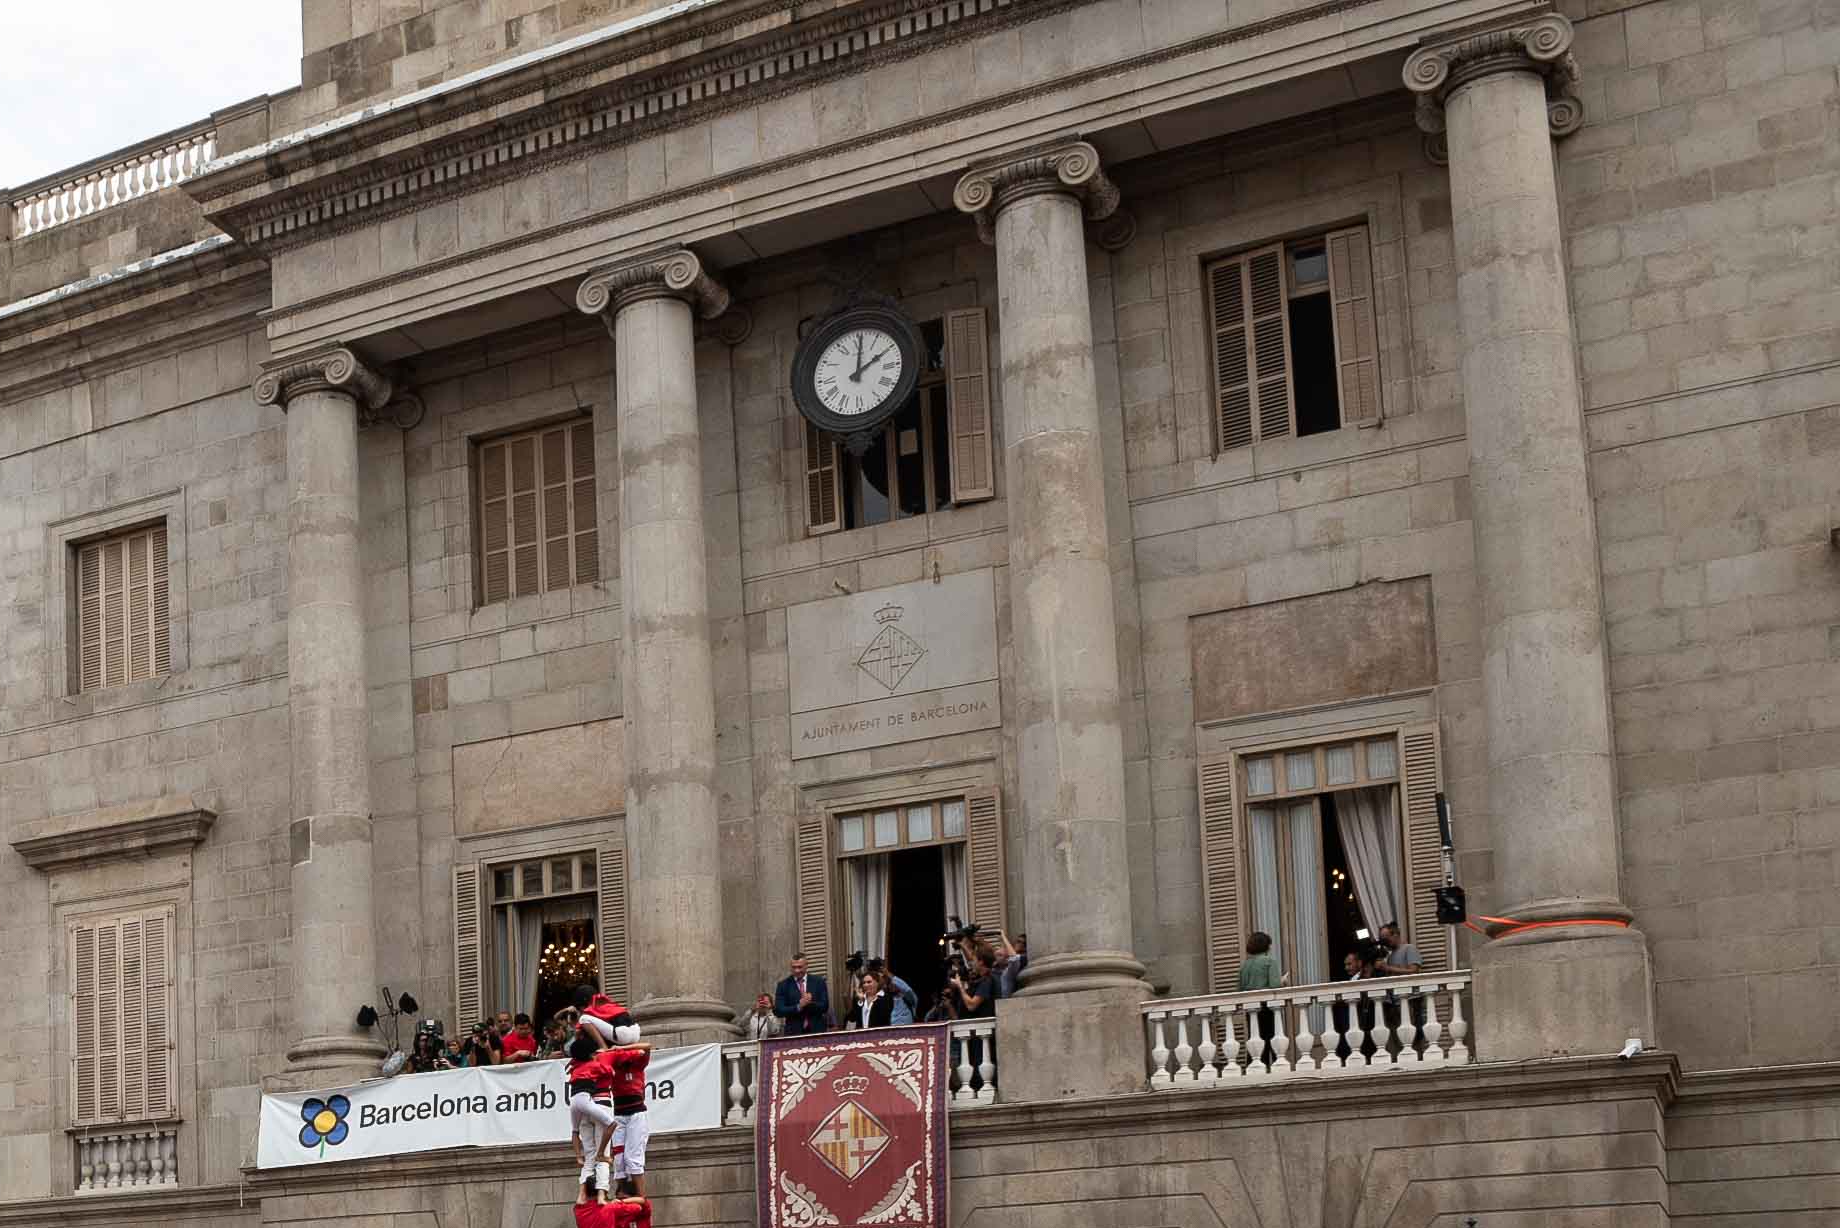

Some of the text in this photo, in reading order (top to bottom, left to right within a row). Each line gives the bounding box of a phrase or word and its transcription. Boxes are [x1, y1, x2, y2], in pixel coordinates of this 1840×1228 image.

[801, 701, 988, 741] AJUNTAMENT DE BARCELONA
[359, 1091, 487, 1128] Barcelona
[495, 1082, 556, 1112] amb
